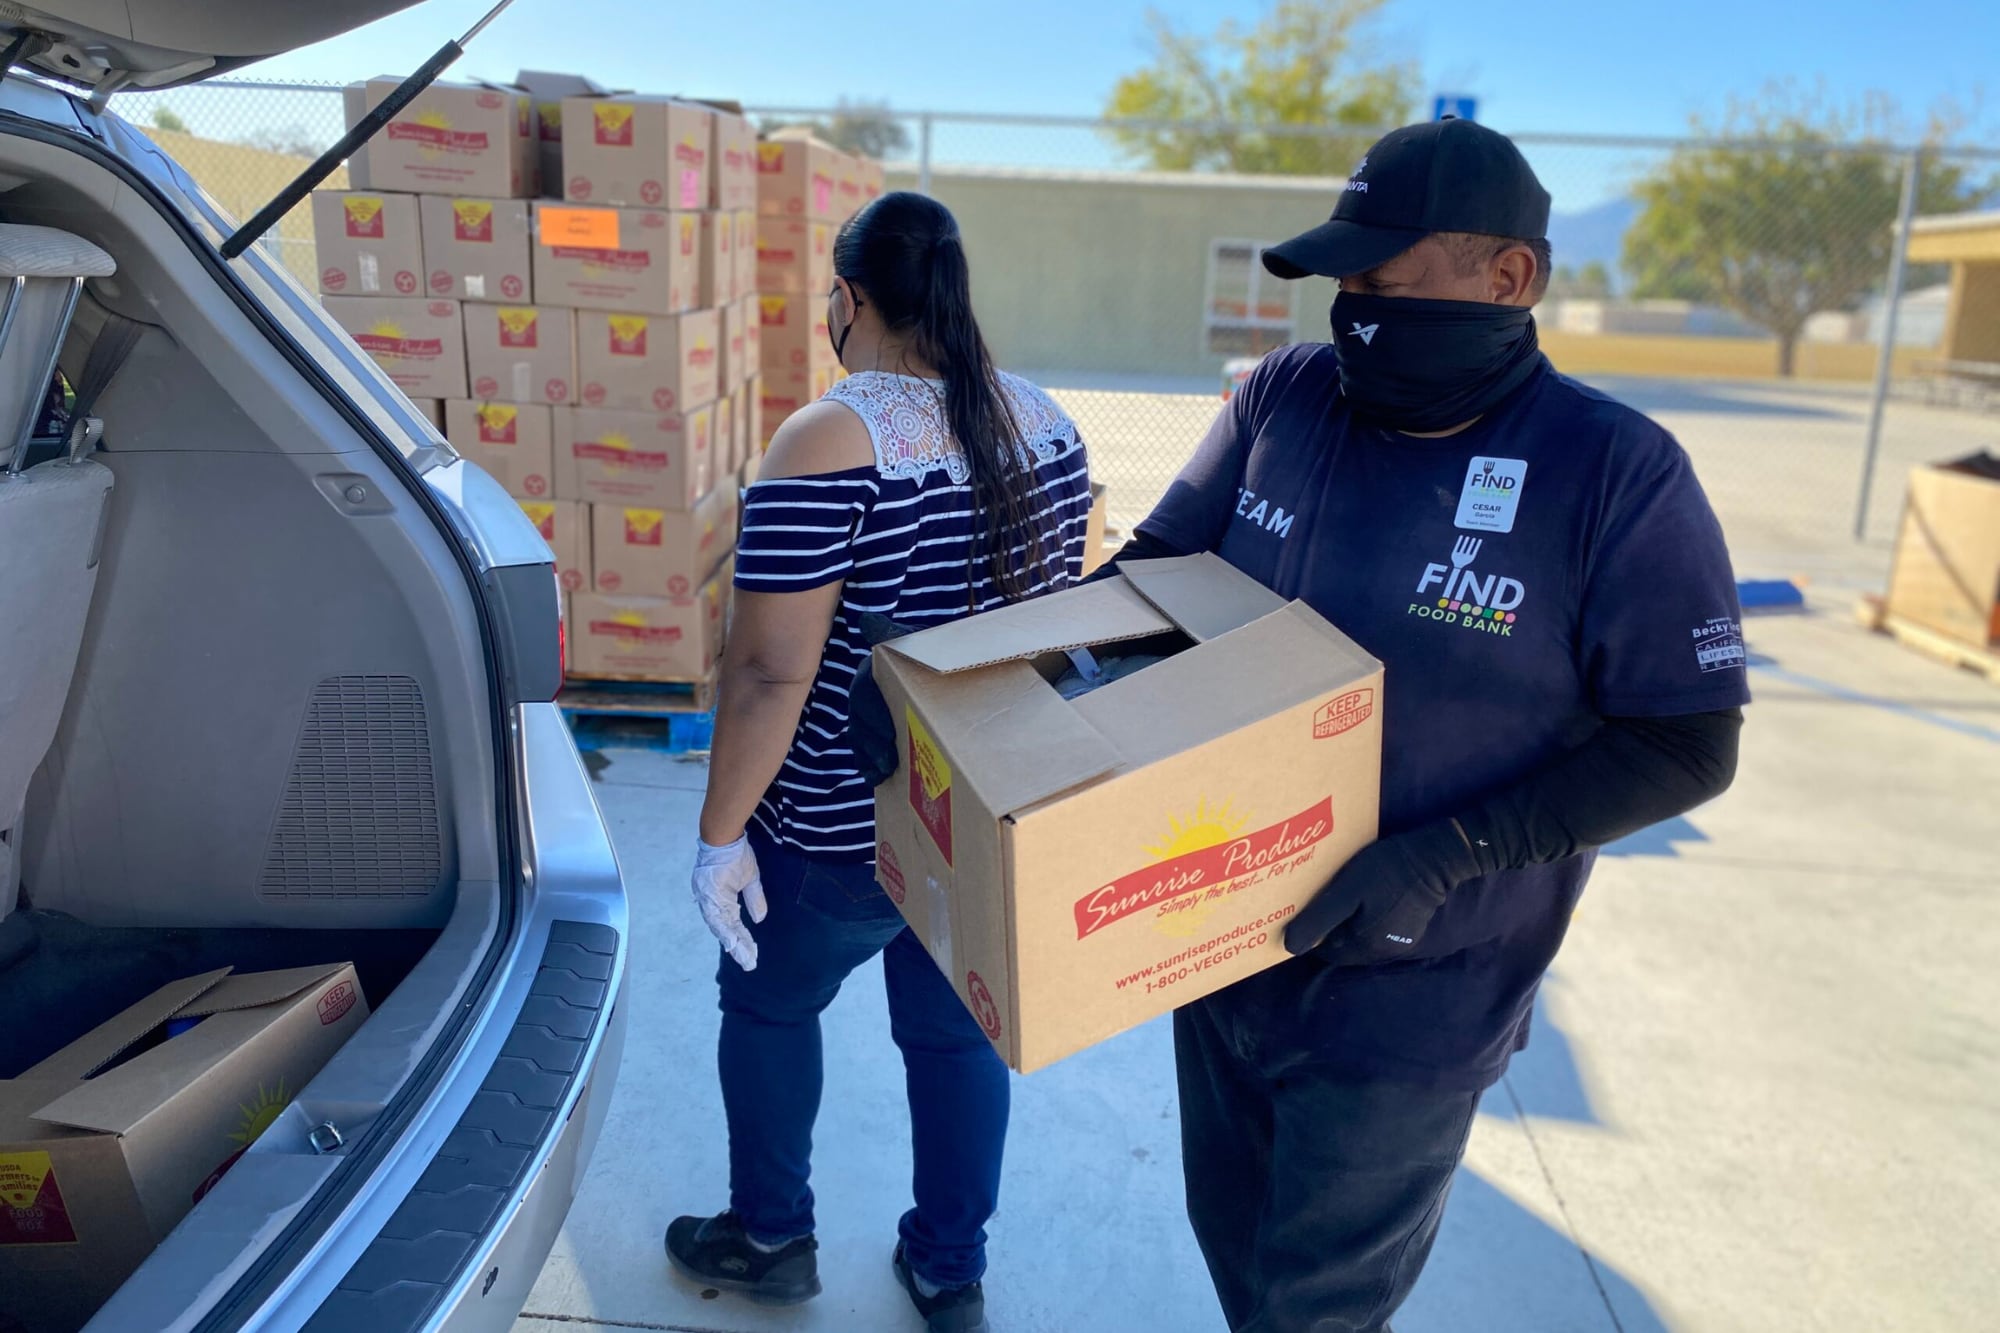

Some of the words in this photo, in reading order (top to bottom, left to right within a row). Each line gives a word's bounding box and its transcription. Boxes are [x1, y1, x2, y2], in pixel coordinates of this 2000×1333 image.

[1471, 473, 1516, 490] FIND
[1236, 488, 1295, 538] EAM
[1472, 503, 1501, 512] CESAR
[1416, 562, 1525, 611] FIND
[1408, 603, 1457, 623] FOOD
[1462, 615, 1513, 637] BANK
[1692, 623, 1728, 638] Becky
[1327, 694, 1360, 719] KEEP
[1315, 706, 1371, 737] REFRIGERATED
[1086, 866, 1205, 933] Sunrise
[1222, 819, 1326, 876] Produce
[1156, 892, 1202, 918] Simply
[1204, 882, 1224, 901] the
[1266, 863, 1288, 880] For
[1290, 846, 1316, 873] you!
[1115, 904, 1296, 990] www.sunriseproduce.com
[1386, 933, 1413, 944] HEAD
[1146, 932, 1268, 994] 1-800-VEGGY-CO
[324, 986, 345, 1009] KEEP
[0, 1181, 38, 1191] amilies
[9, 1207, 44, 1219] FOOD
